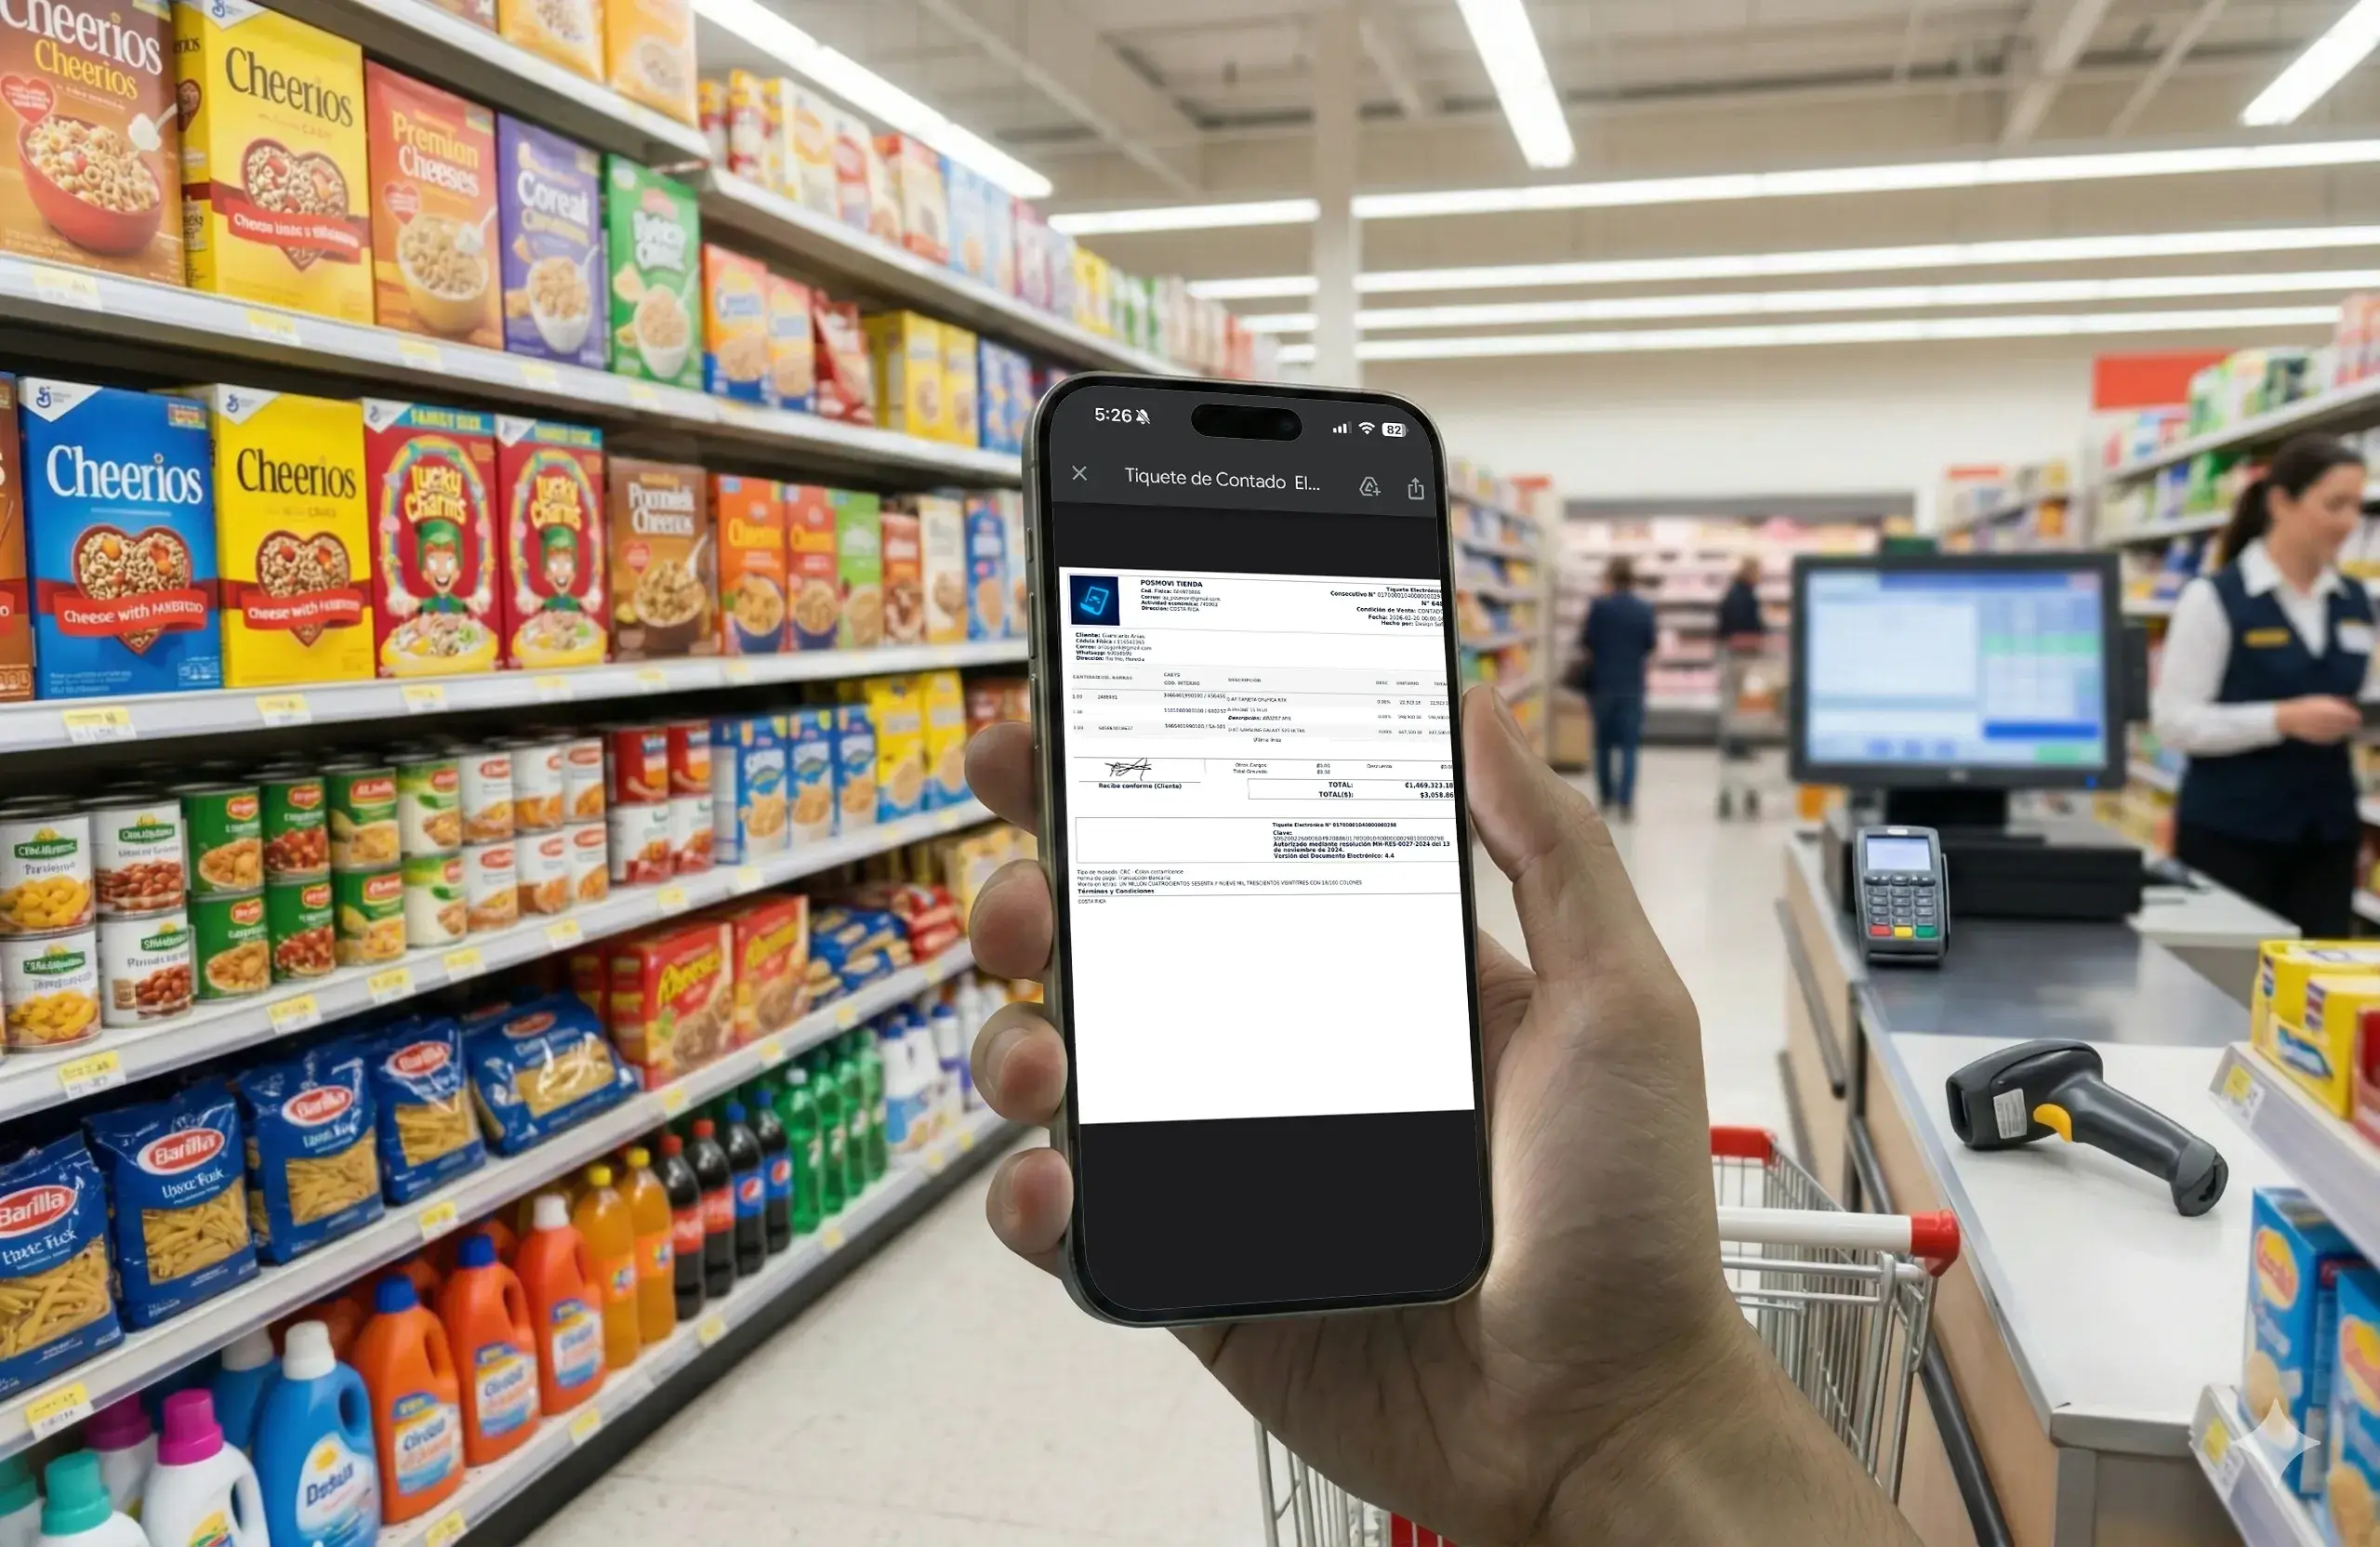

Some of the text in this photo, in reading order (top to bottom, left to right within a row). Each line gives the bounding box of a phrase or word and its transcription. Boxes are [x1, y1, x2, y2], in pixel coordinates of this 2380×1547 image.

[0, 0, 163, 75] Cheerios
[34, 39, 139, 100] Cheerios
[225, 46, 353, 128] Cheerios
[1094, 407, 1132, 424] 5:26
[1386, 424, 1402, 436] 82
[46, 444, 204, 505] Cheerios
[236, 448, 356, 499] Cheerios
[1125, 468, 1187, 487] Tiquete
[1190, 470, 1212, 486] de
[1216, 471, 1287, 489] Contado
[63, 609, 115, 625] Cheese
[117, 603, 151, 622] with
[0, 1191, 65, 1227] Barilla
